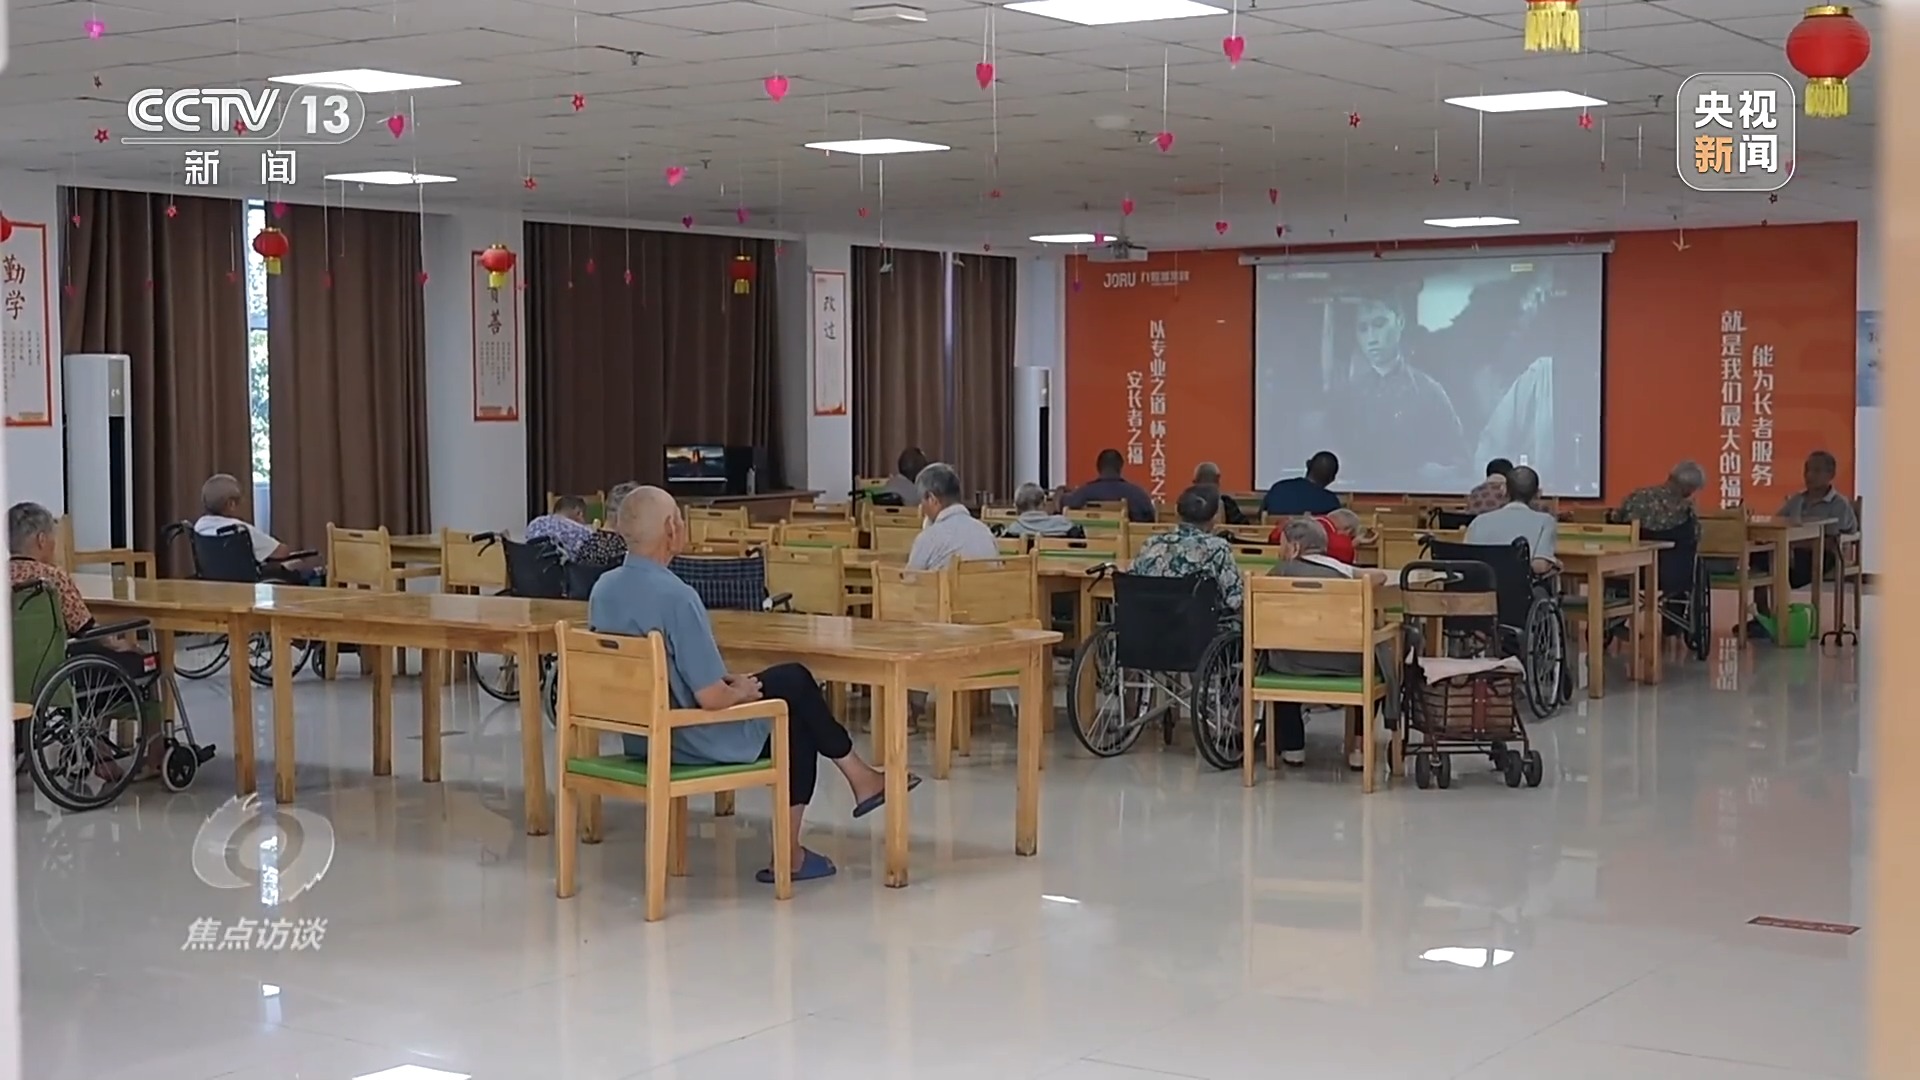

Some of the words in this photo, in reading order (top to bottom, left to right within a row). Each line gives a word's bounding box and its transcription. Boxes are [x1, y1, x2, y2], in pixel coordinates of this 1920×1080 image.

[3, 254, 26, 320] 勤学
[1103, 272, 1137, 288] JORU
[1150, 319, 1166, 415] 以专业之道
[1127, 370, 1143, 464] 安长者之福
[1751, 344, 1775, 487] 能为长者服务
